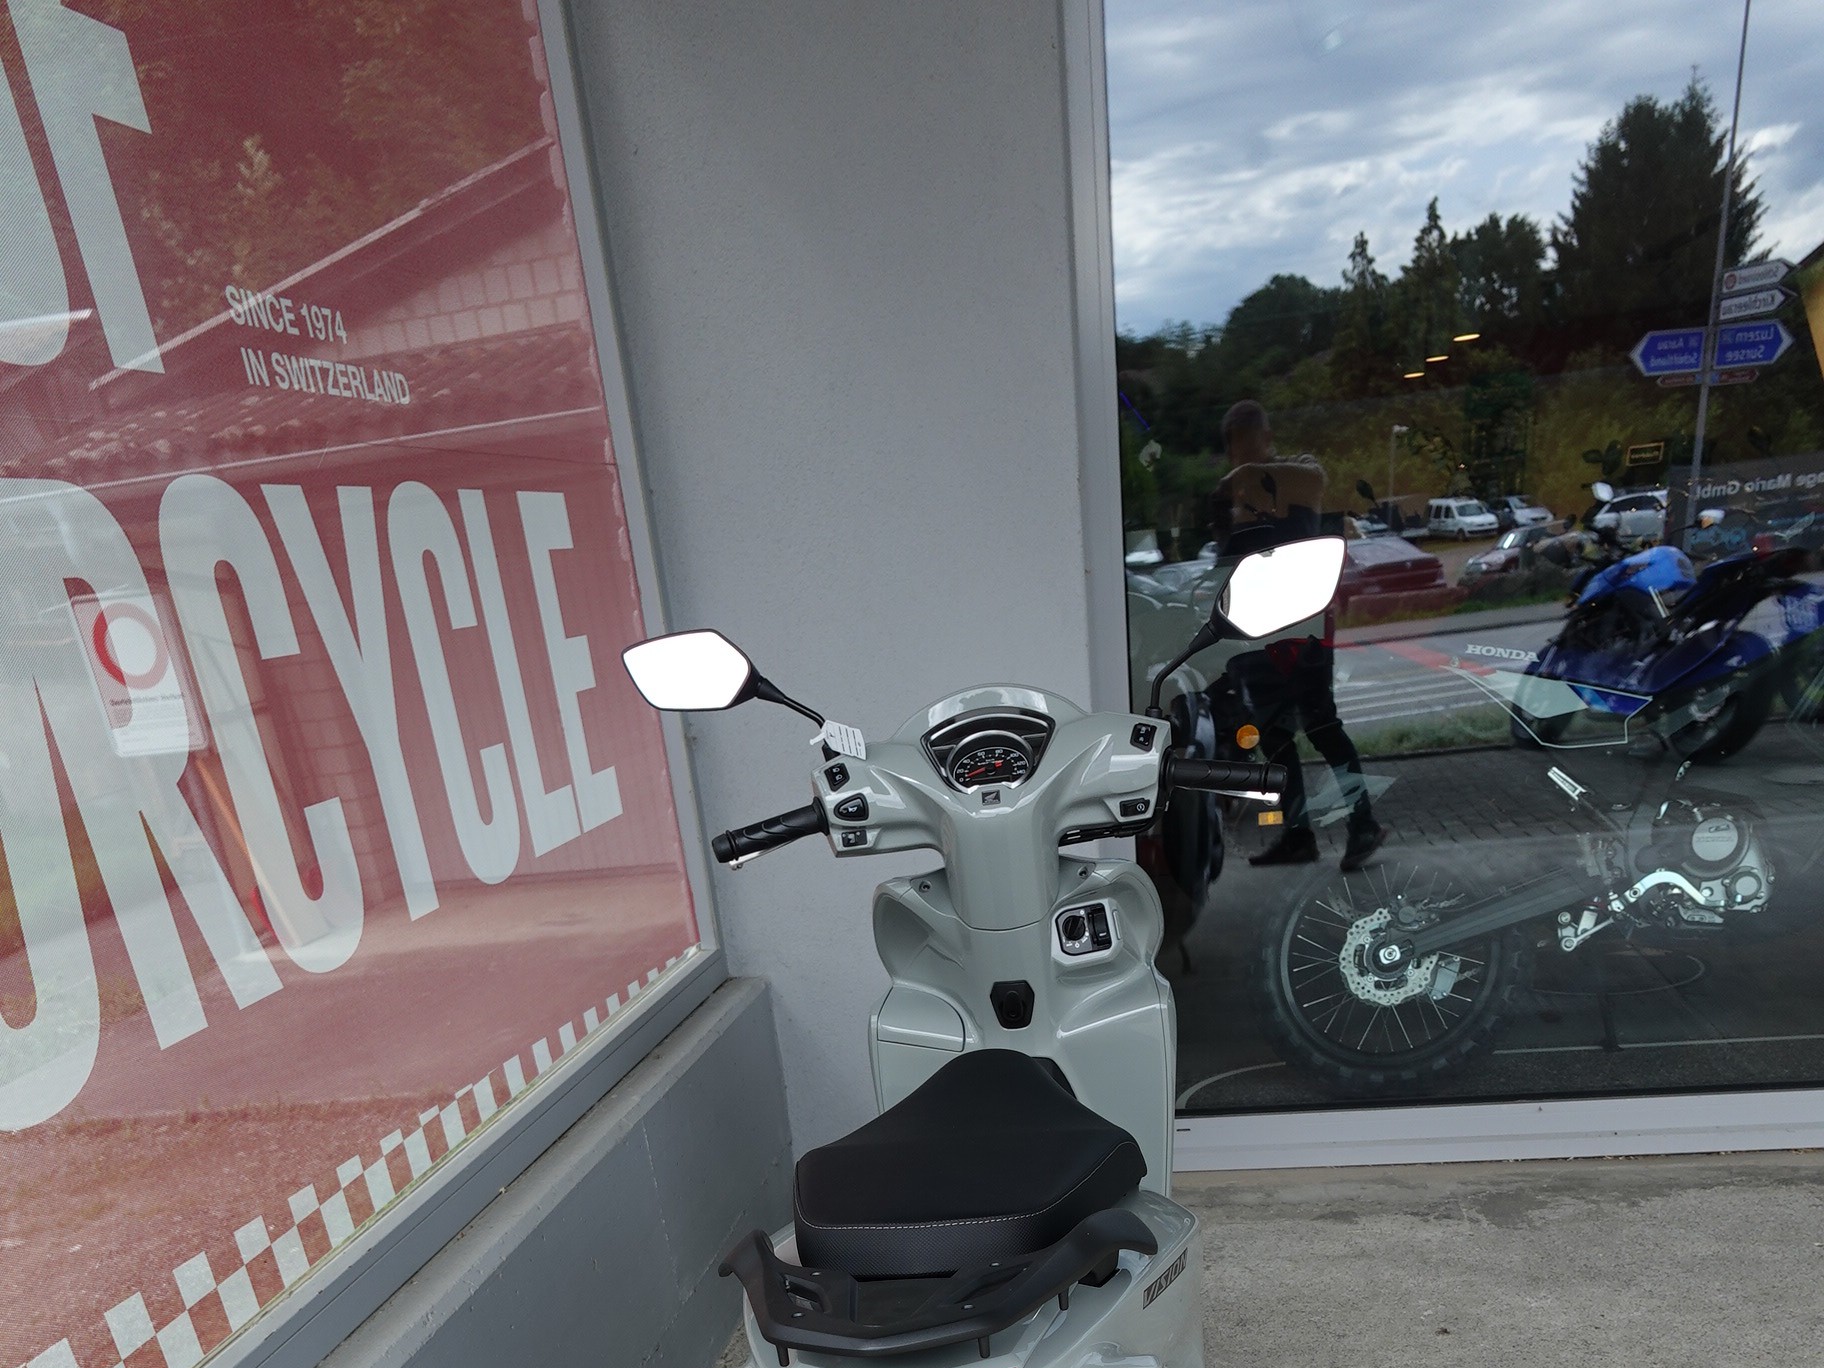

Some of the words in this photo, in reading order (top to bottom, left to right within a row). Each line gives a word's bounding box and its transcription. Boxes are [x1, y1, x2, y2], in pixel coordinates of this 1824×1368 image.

[225, 284, 300, 336] SINCE
[301, 303, 348, 345] 1974
[240, 347, 270, 387] IN
[271, 352, 410, 405] SWITZERLAND
[1464, 643, 1540, 662] HONDA
[1143, 1249, 1187, 1309] VISION
